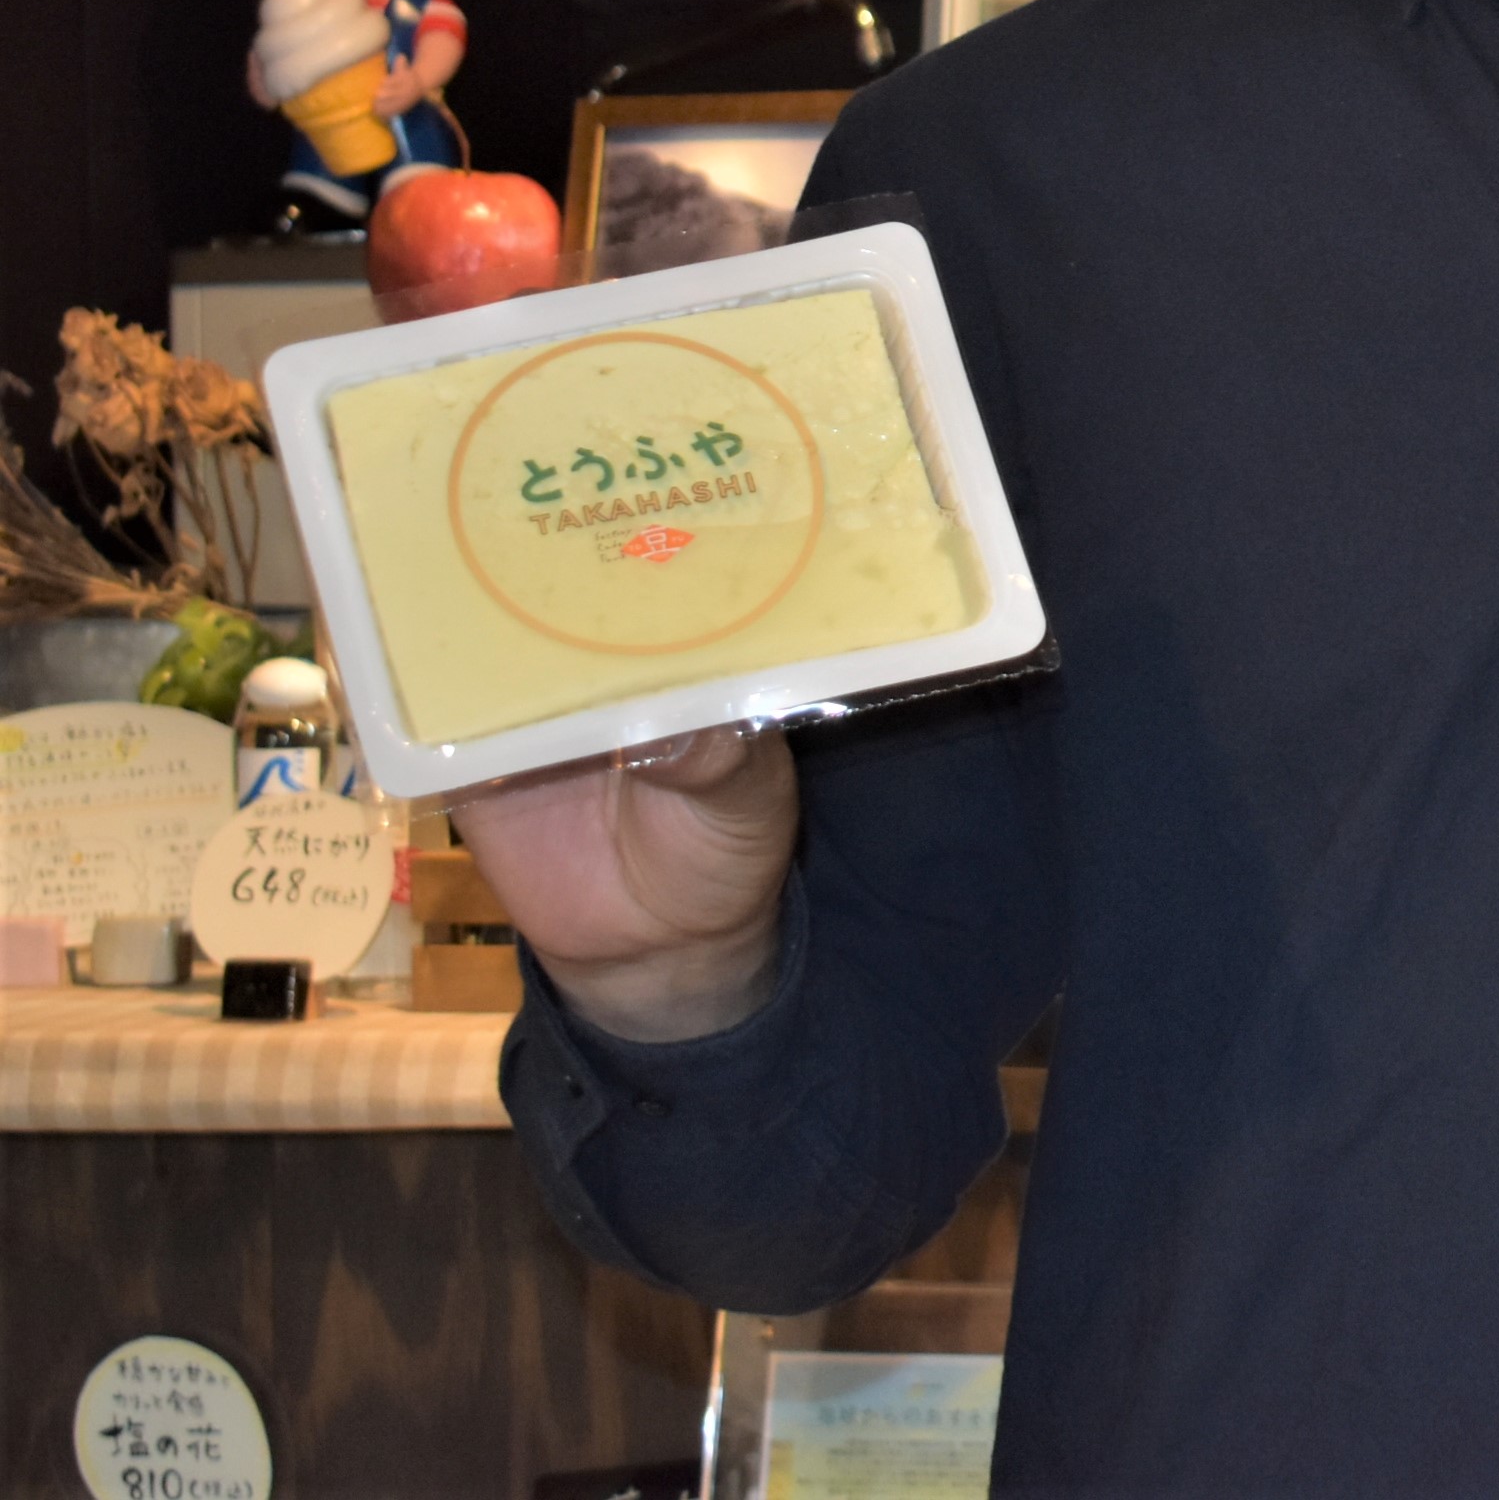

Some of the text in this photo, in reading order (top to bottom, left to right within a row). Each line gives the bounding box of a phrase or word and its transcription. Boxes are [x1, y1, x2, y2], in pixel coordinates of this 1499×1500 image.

[519, 421, 743, 504] とうふや
[529, 471, 758, 536] TAKAHASHI
[244, 826, 371, 861] 天然にがり
[98, 1412, 223, 1463] 塩の花
